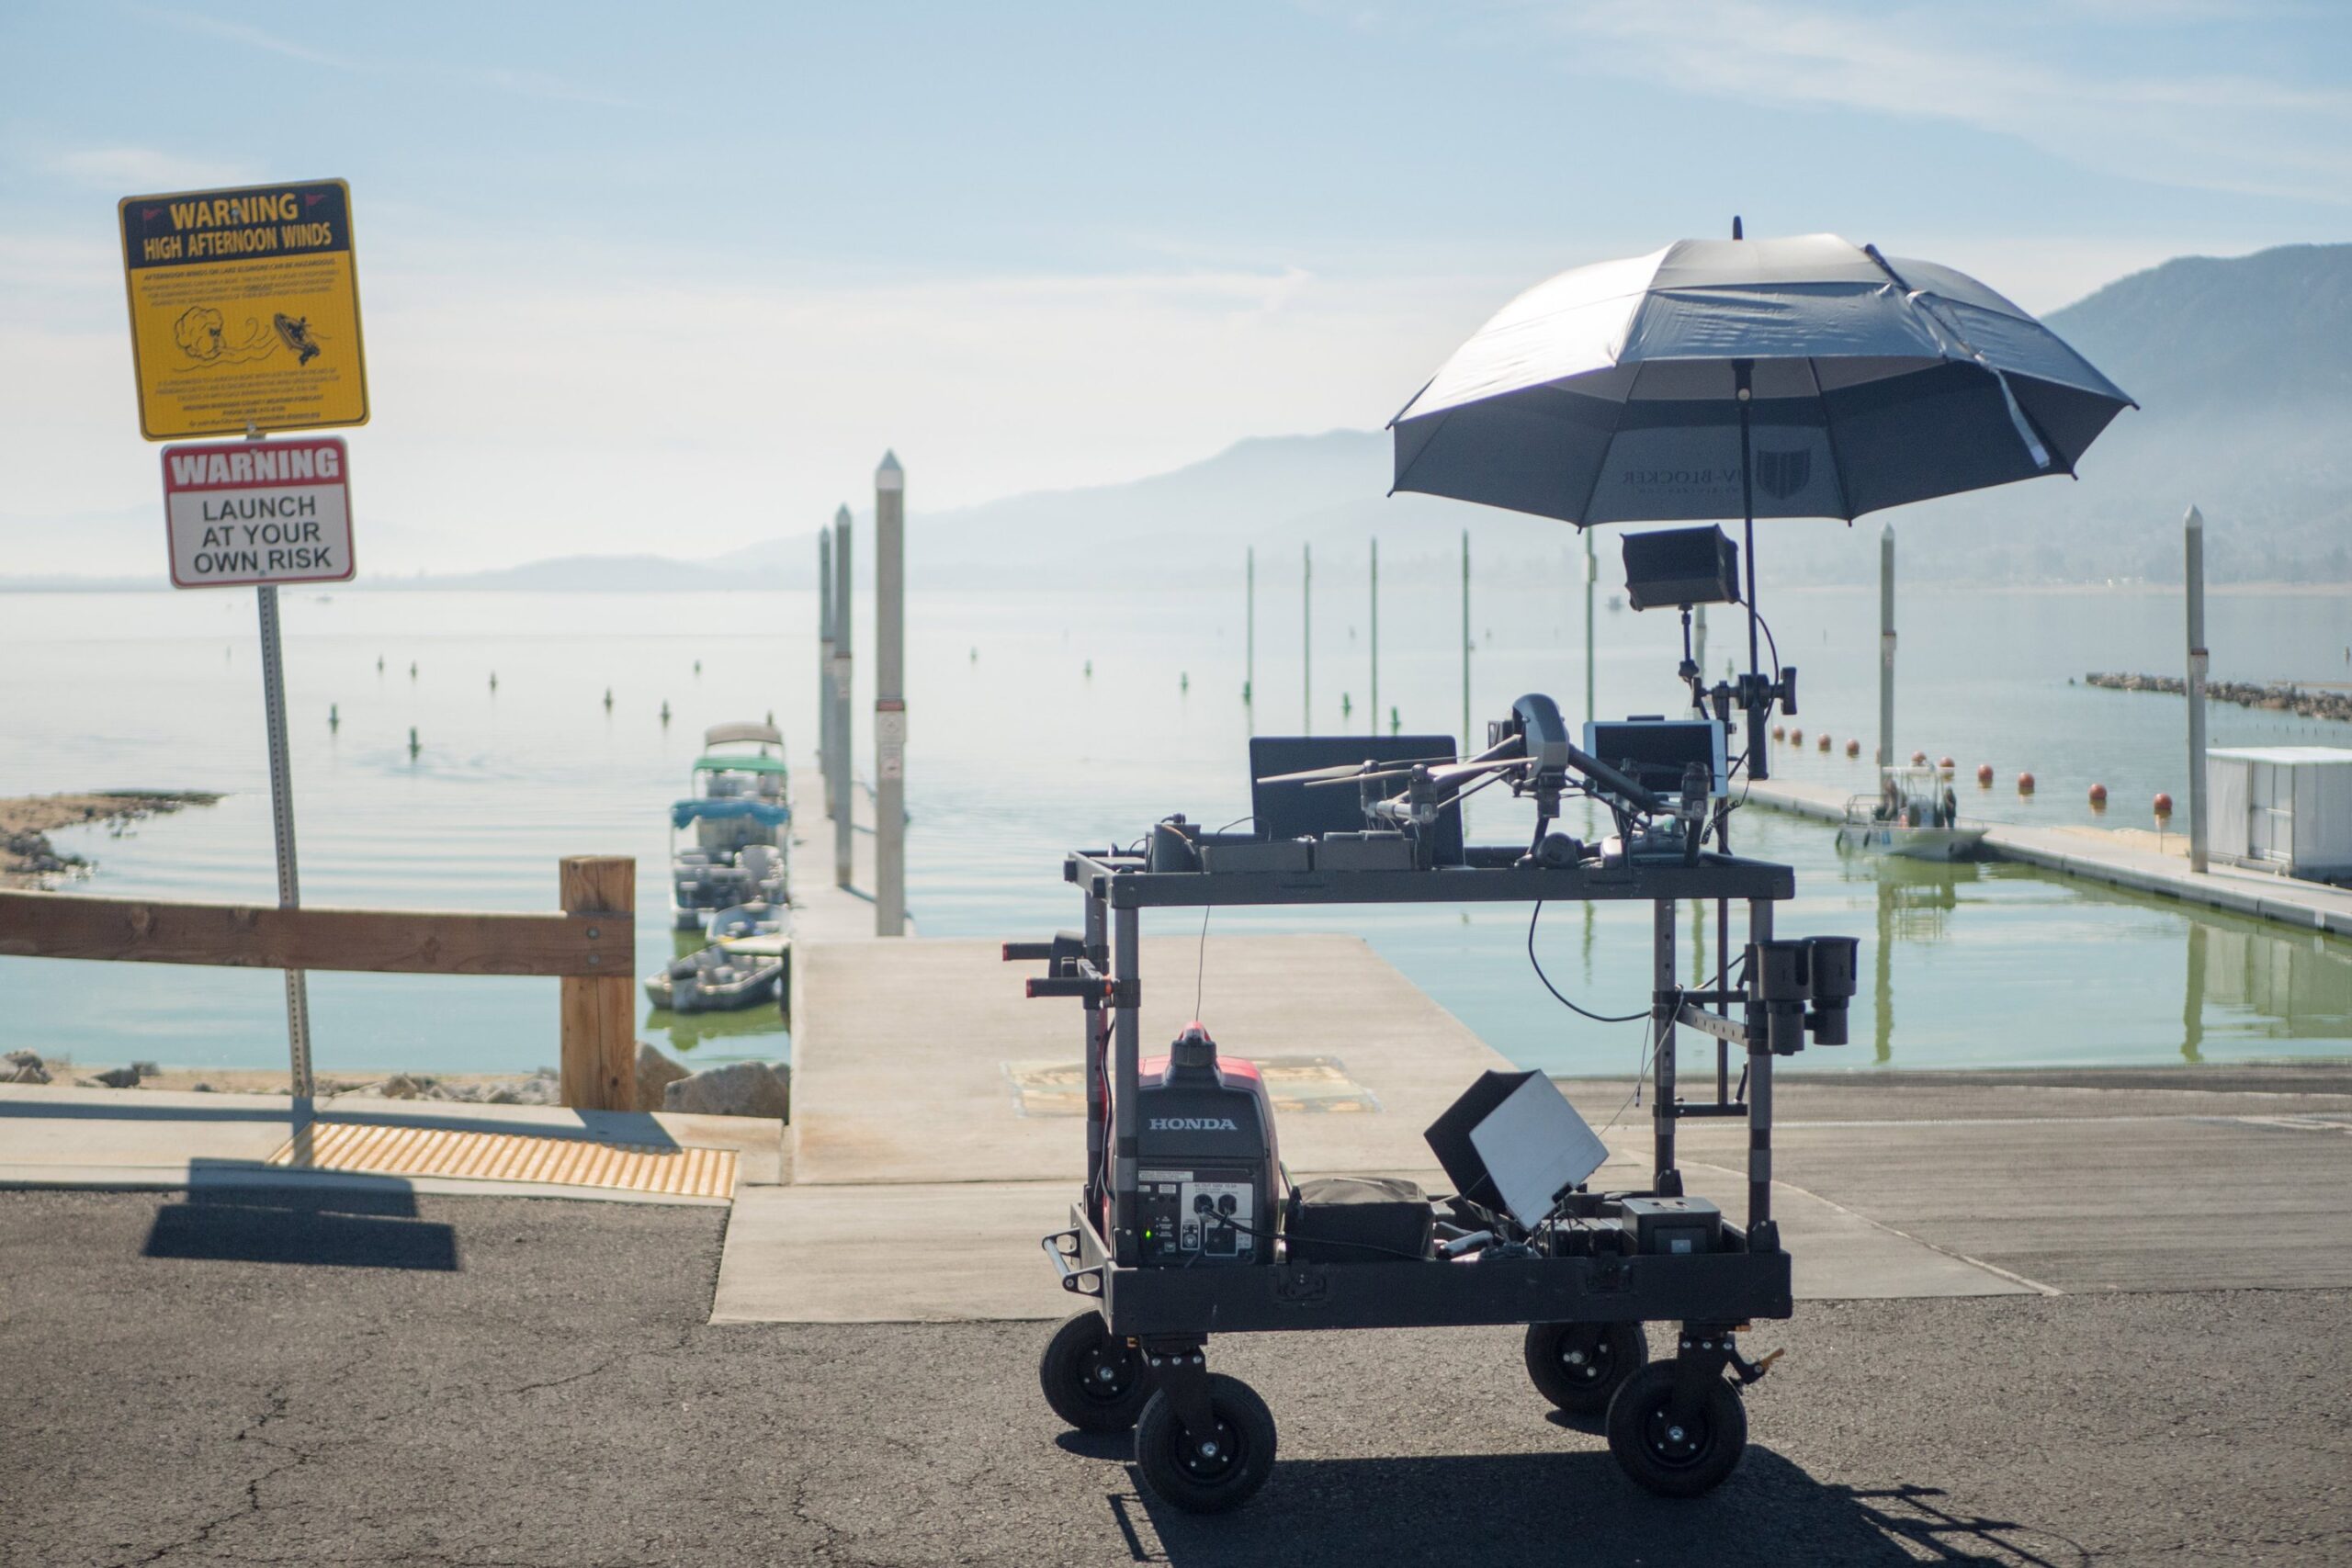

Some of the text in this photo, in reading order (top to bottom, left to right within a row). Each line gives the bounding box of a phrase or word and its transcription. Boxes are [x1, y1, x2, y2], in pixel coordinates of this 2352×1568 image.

[169, 193, 299, 231] WARNING
[143, 221, 333, 262] HIGH AFTERNOON WINDS
[170, 447, 339, 486] WARNING
[203, 495, 316, 522] LAUNCH
[202, 522, 321, 547] AT YOUR
[194, 547, 333, 574] OWN RISK
[1148, 1118, 1238, 1131] HONDA
